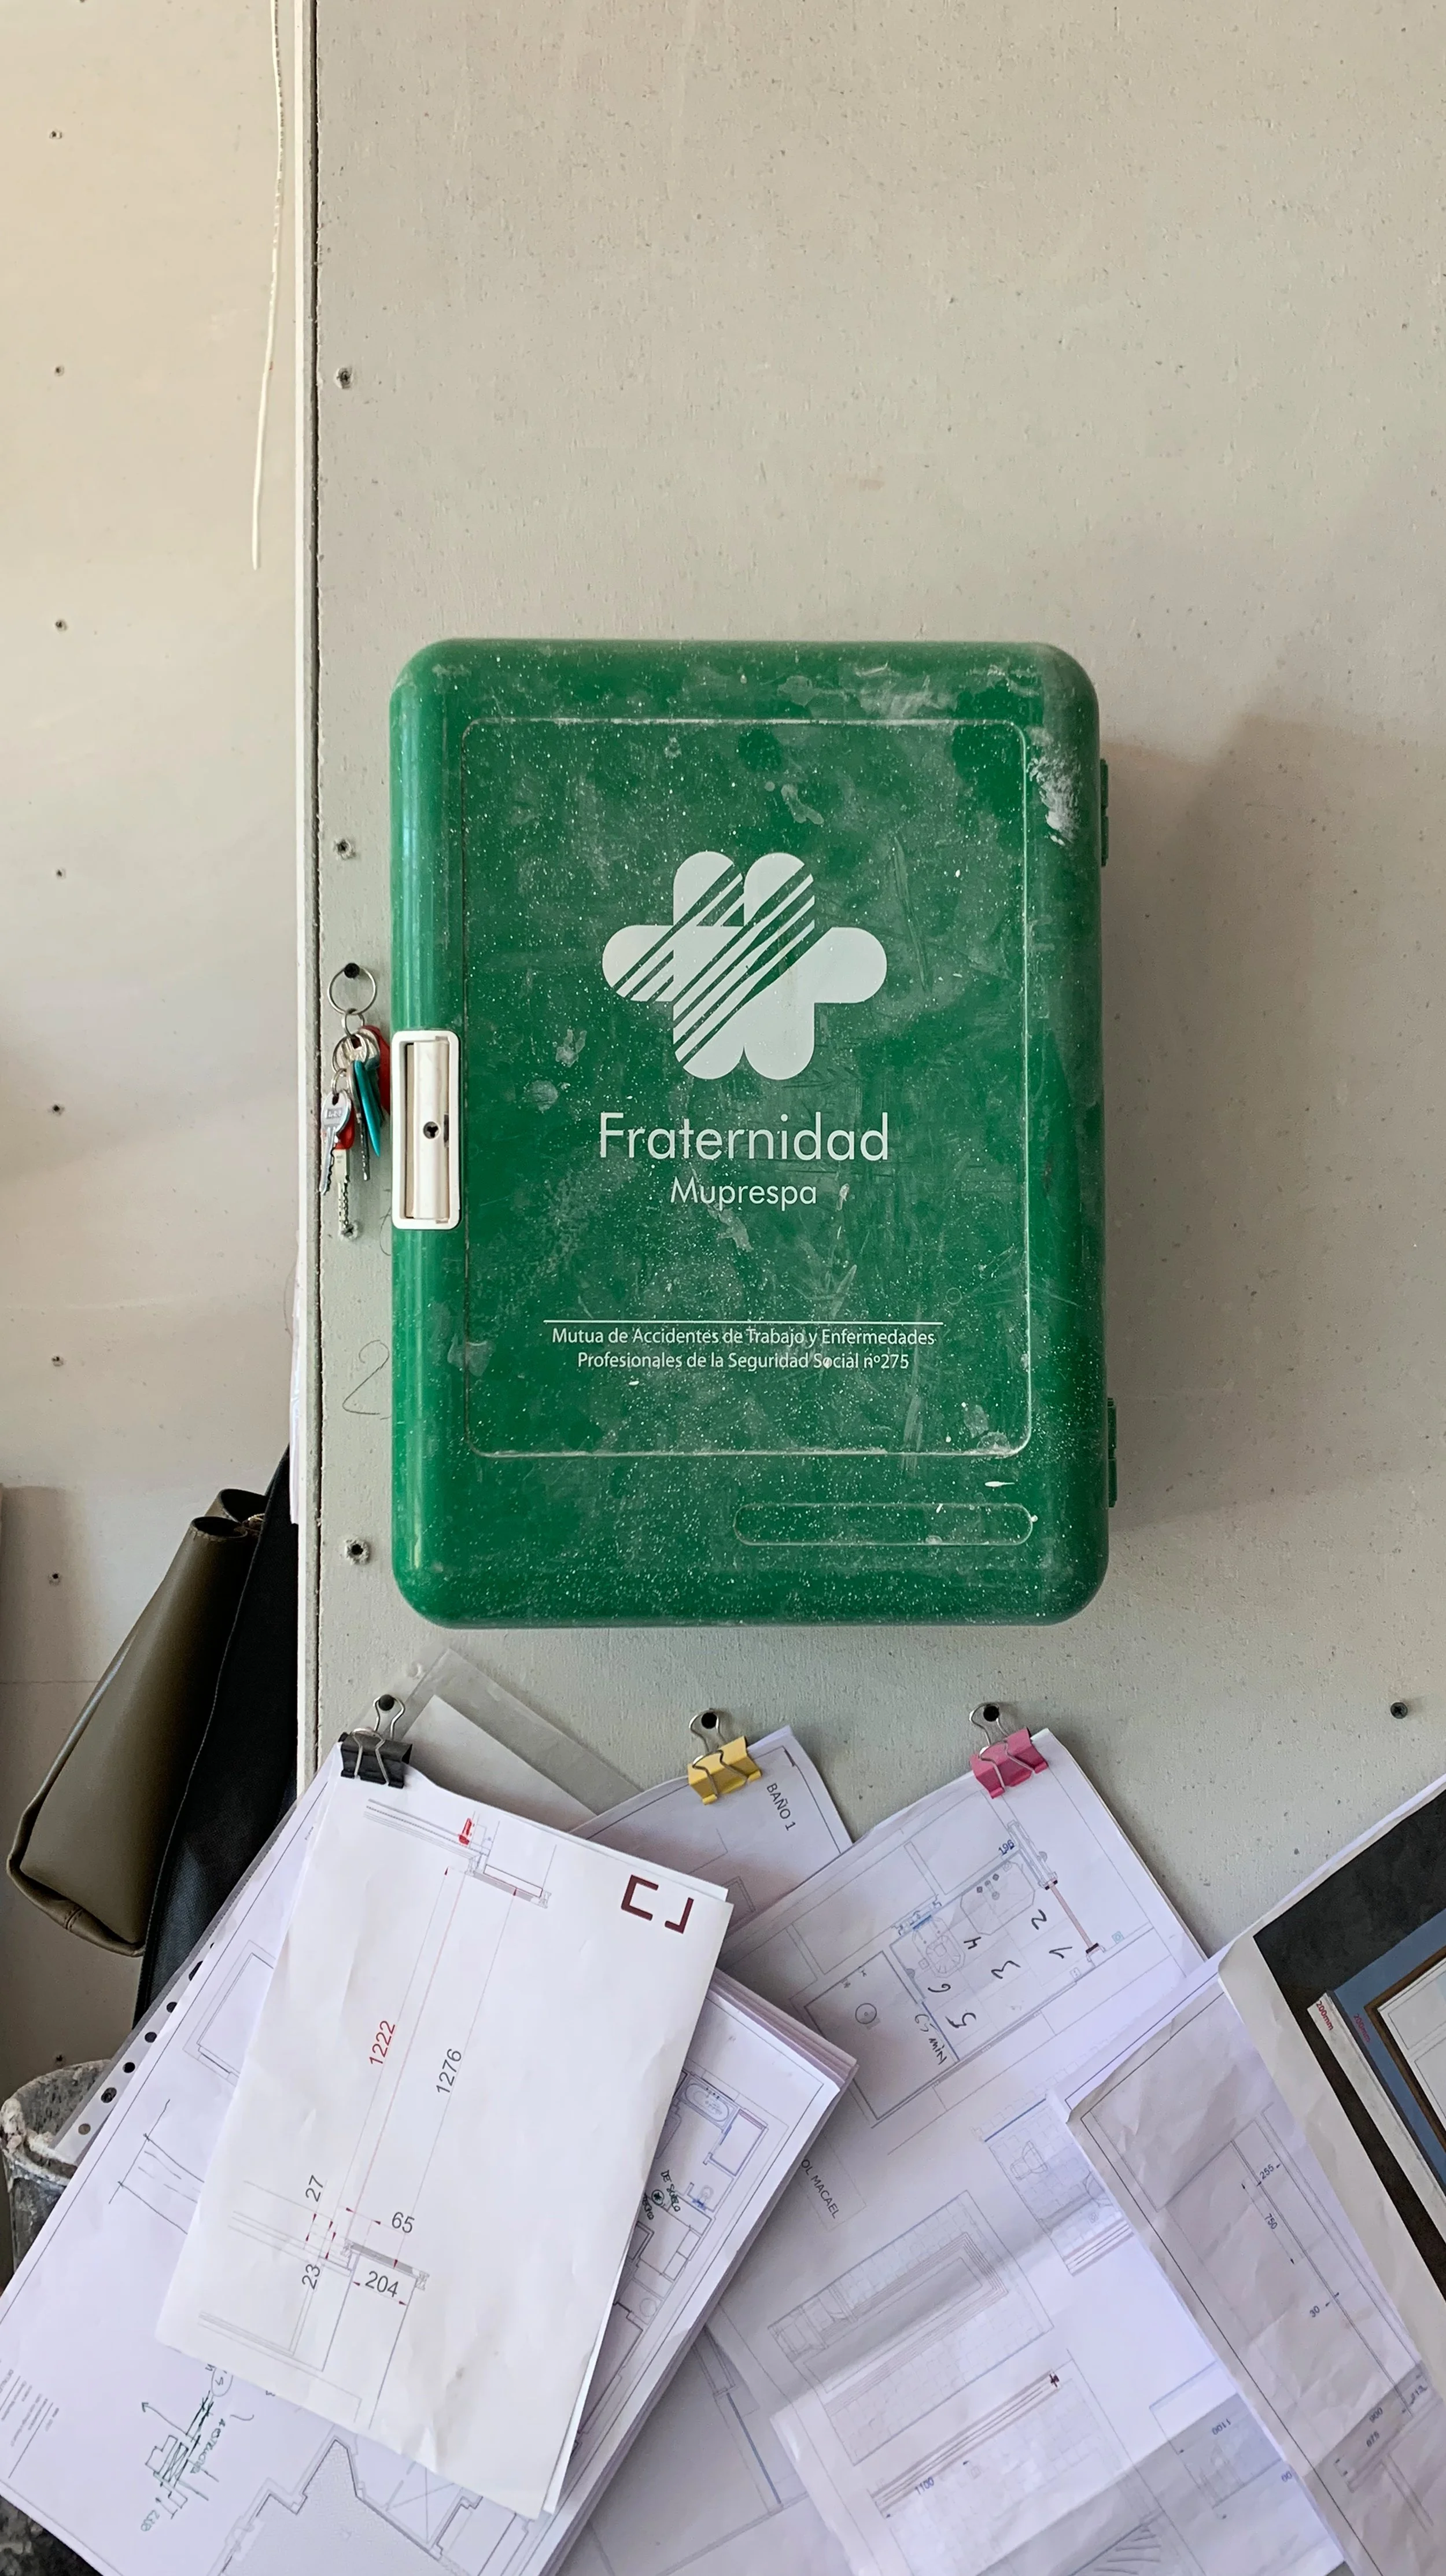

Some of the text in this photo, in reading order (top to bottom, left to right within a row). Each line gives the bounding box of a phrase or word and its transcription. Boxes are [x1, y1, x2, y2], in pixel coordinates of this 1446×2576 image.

[600, 1111, 888, 1160] Fraternidad
[670, 1176, 817, 1211] Muprespa
[552, 1328, 935, 1348] Mutua de Accidentes de Trabajo y Enfermedades
[578, 1352, 683, 1368] Profesionales
[687, 1352, 707, 1368] de
[711, 1352, 724, 1368] la
[728, 1353, 809, 1372] Seguridad
[813, 1353, 859, 1369] Social
[766, 1783, 796, 1831] BAÑO 1
[998, 1839, 1015, 1856] 196
[1031, 1909, 1047, 1930] 2
[990, 1960, 1021, 1979] 3
[1316, 2000, 1334, 2031] 200mm
[369, 2020, 396, 2065] 1222
[436, 2048, 462, 2093] 1276
[305, 2175, 324, 2202] 27
[801, 2159, 839, 2219] OL MACAEL
[391, 2212, 415, 2234] 65
[1264, 2213, 1278, 2230] 750
[301, 2264, 321, 2290] 23
[364, 2271, 399, 2298] 204
